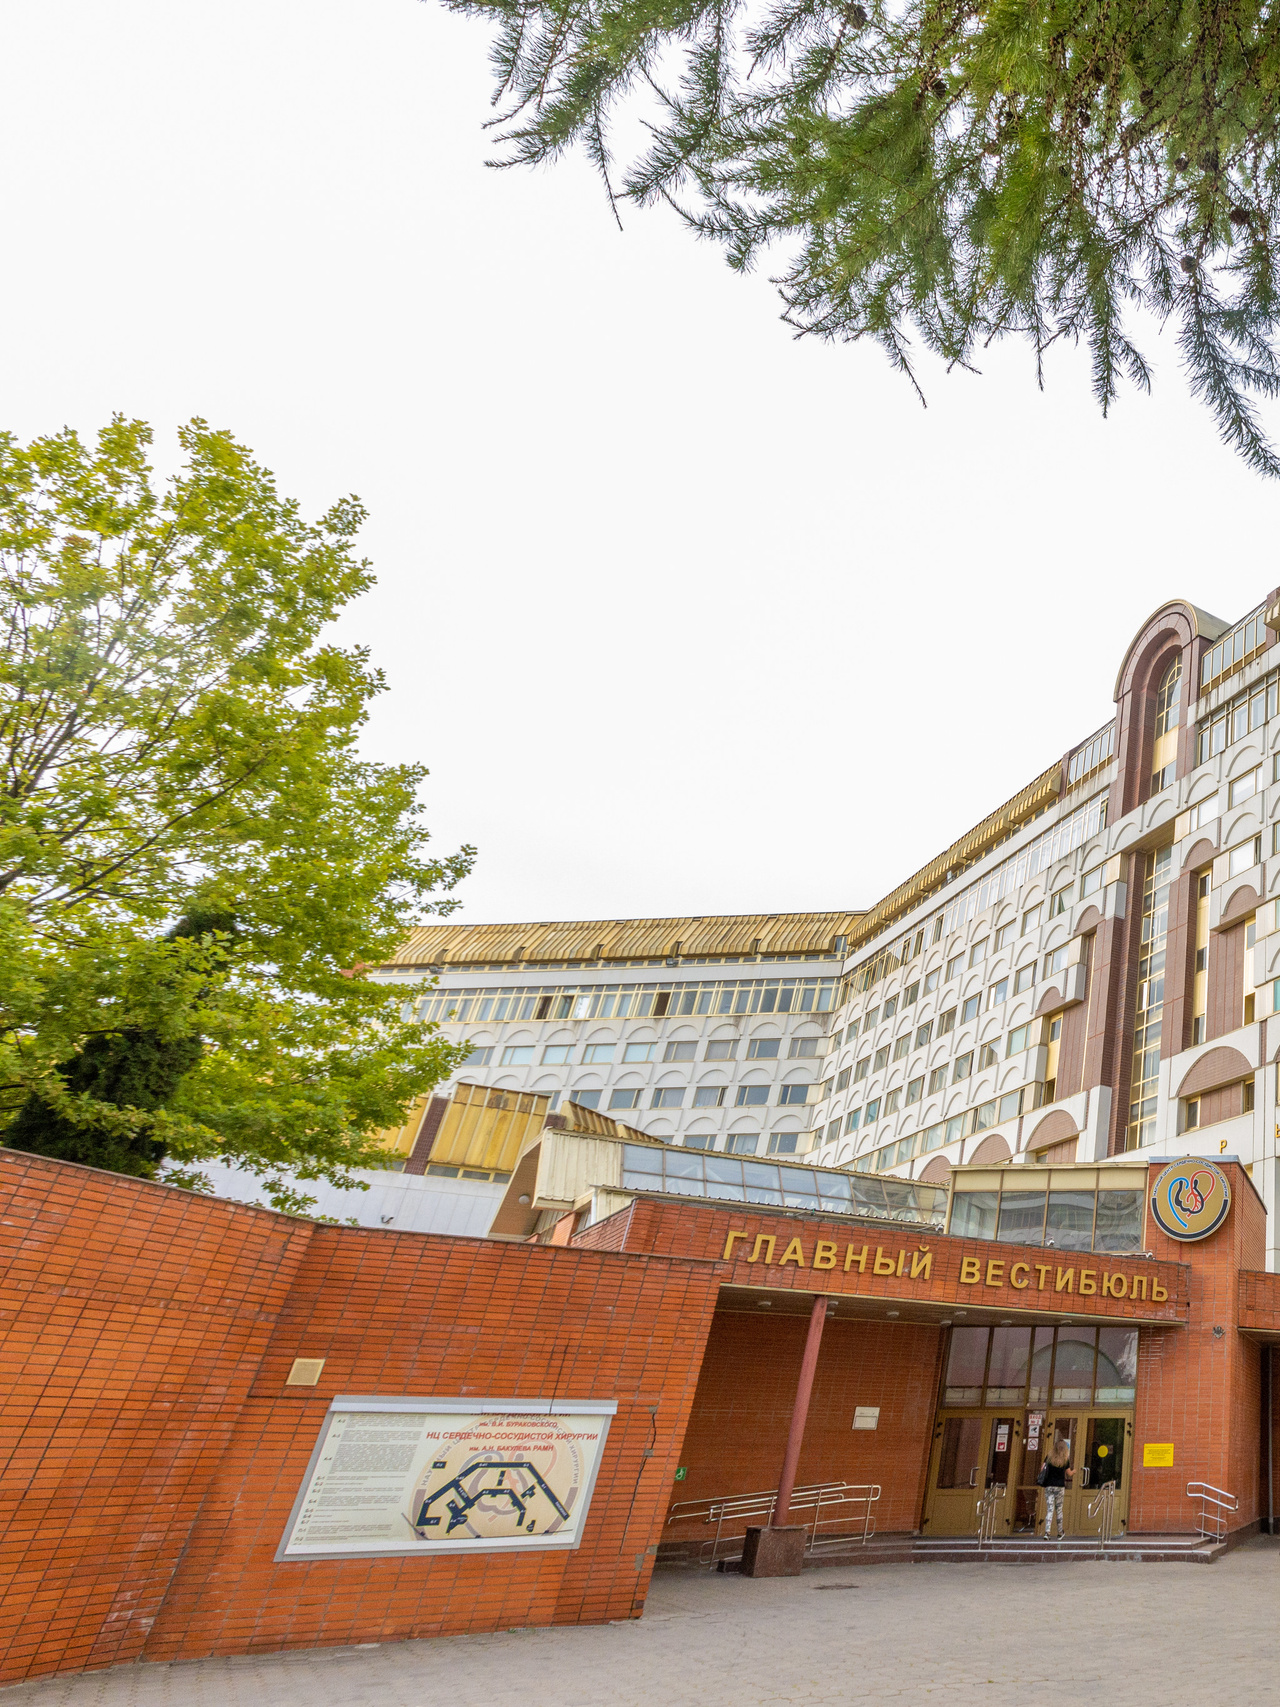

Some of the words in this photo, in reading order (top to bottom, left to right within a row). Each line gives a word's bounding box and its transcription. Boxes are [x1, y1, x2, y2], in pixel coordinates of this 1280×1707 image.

[723, 1230, 933, 1280] ГЛАВНЫЙ
[960, 1255, 1169, 1302] ВЕСТИБЮЛЬ
[426, 1432, 441, 1440] НЦ
[444, 1431, 553, 1441] СЕРДЕЧНО-СОСУДИСТОЙ
[554, 1432, 599, 1441] ХИРУРГИИ
